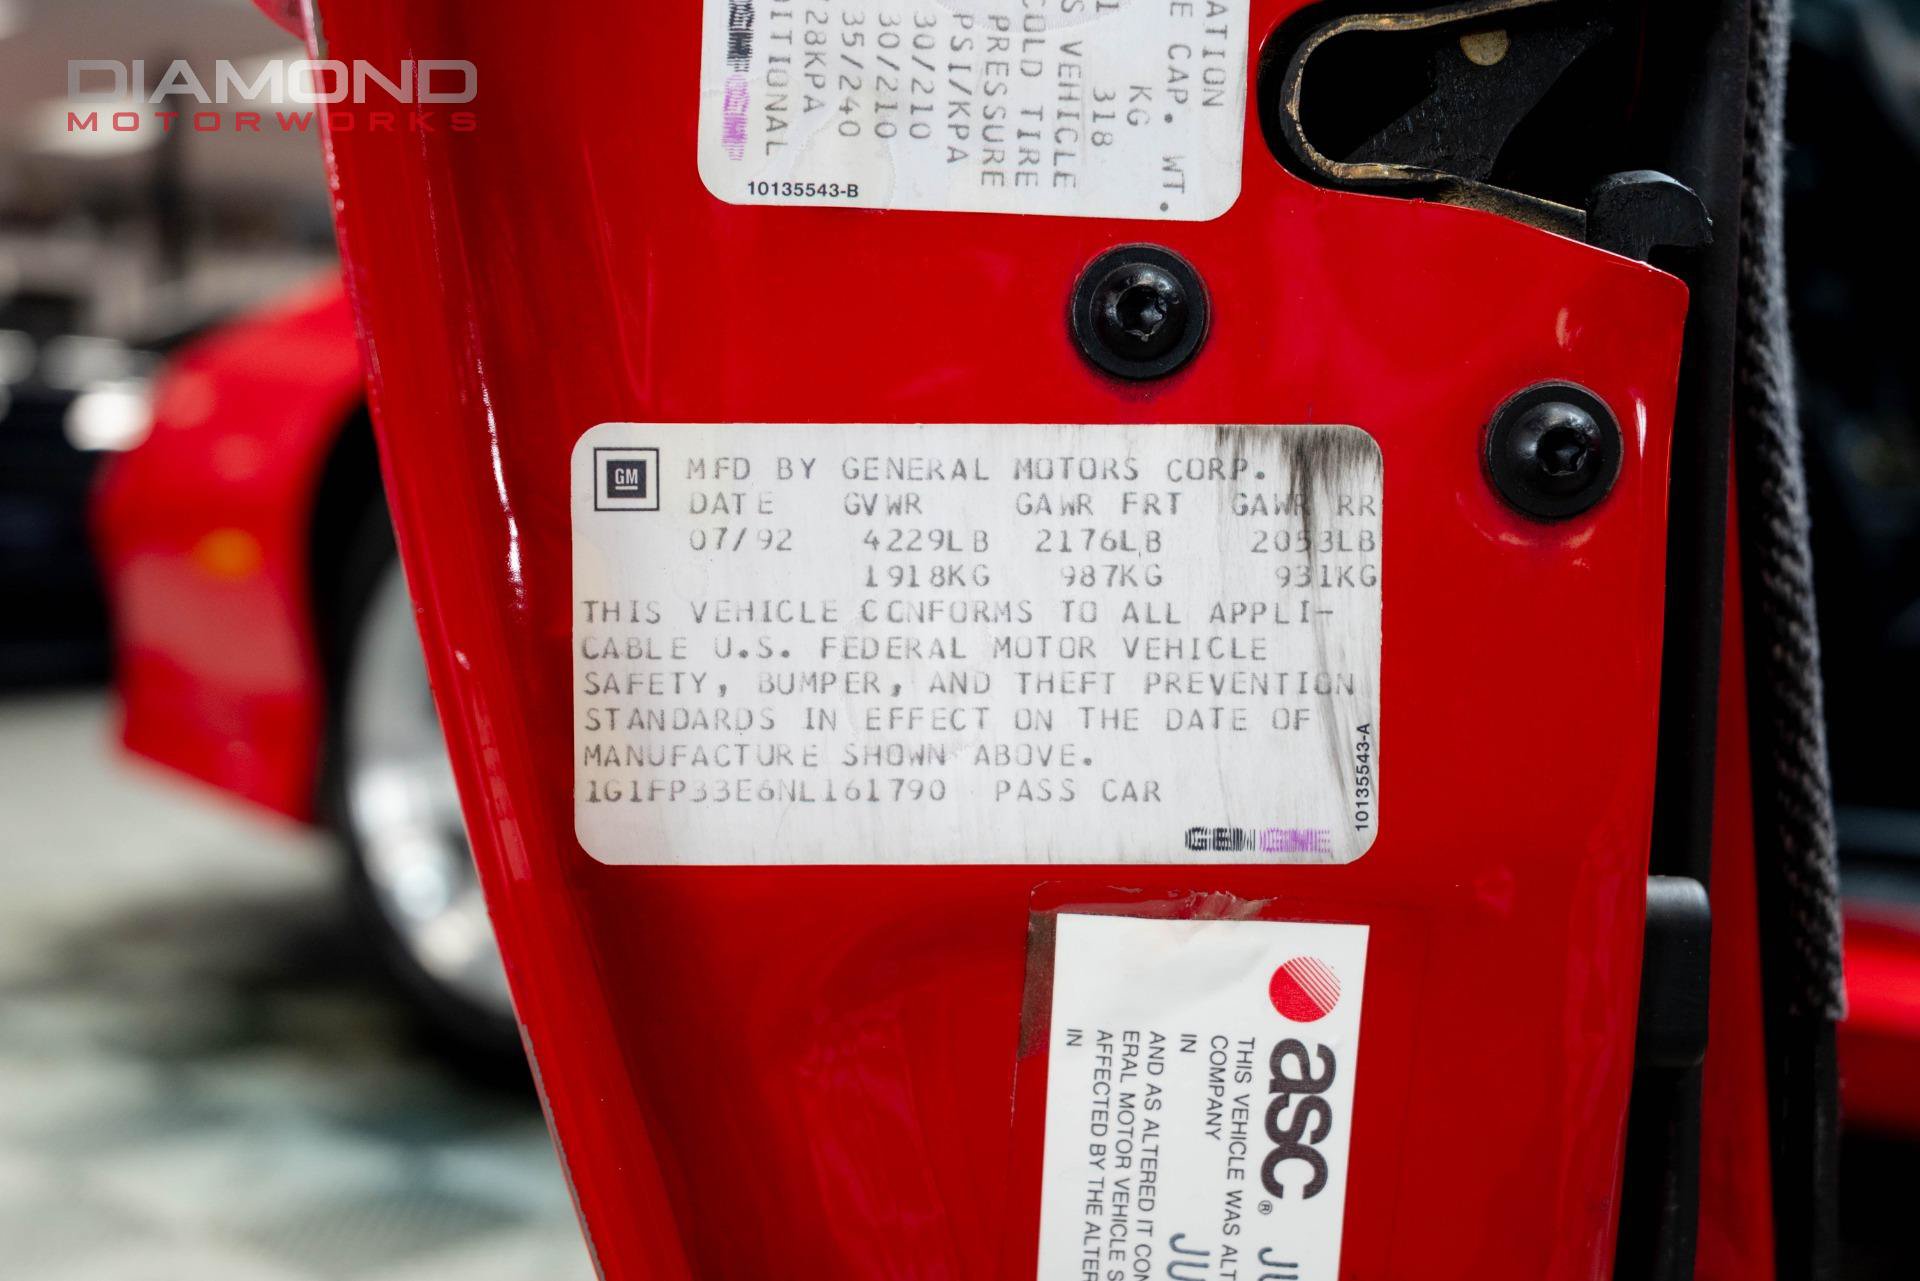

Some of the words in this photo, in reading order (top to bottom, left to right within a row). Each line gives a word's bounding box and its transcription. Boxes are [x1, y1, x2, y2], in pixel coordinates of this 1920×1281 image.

[764, 0, 792, 156] ITIONAL
[803, 0, 829, 113] 28KPA
[838, 12, 865, 137] 35/240
[874, 13, 901, 139] 30/210
[909, 11, 937, 140] 30/210
[1202, 0, 1228, 107] ATION
[947, 13, 975, 164] PSI/KPA
[981, 14, 1011, 187] PRESSURE
[1126, 85, 1153, 127] KG
[1163, 44, 1192, 124] CAP.
[1053, 41, 1083, 189] VEHICLE
[1091, 87, 1117, 147] 318
[1014, 106, 1044, 187] TIRE
[747, 181, 859, 198] 10135543-B
[1159, 154, 1186, 212] WT.
[614, 467, 639, 485] GM
[686, 456, 751, 481] MFD
[776, 456, 817, 481] BY
[842, 457, 990, 481] GENERAL
[1013, 457, 1140, 481] MOTORS
[1166, 457, 1266, 483] CORP.
[688, 492, 775, 515] DATE
[844, 492, 924, 516] GVWR
[1015, 492, 1094, 517] GAWR
[1122, 492, 1183, 516] FRT
[1231, 492, 1311, 517] GAWR
[1336, 493, 1377, 517] RR
[689, 528, 793, 551] 07/92
[863, 528, 990, 553] 4229LB
[1035, 528, 1162, 553] 2176LB
[865, 564, 991, 588] 1918KG
[1060, 564, 1163, 588] 987KG
[1274, 564, 1378, 588] 931KG
[583, 600, 661, 624] THIS
[690, 600, 838, 624] VEHICLE
[860, 600, 1033, 624] CONFORMS
[1062, 600, 1099, 624] TO
[1121, 600, 1182, 624] ALL
[1209, 600, 1334, 624] APPLI-
[581, 636, 688, 660] CABLE
[714, 636, 791, 660] U.S.
[820, 636, 967, 660] FEDERAL
[993, 636, 1098, 660] MOTOR
[1122, 636, 1267, 660] VEHICLE
[583, 671, 728, 696] SAFETY,
[758, 672, 902, 697] BUMPER,
[929, 672, 992, 696] AND
[1018, 671, 1117, 696] THEFT
[1143, 672, 1355, 696] PREVENTION
[584, 707, 776, 731] STANDARDS
[805, 707, 838, 731] IN
[865, 707, 991, 731] EFFECT
[1014, 708, 1054, 732] ON
[1078, 707, 1140, 732] THE
[1165, 708, 1249, 732] DATE
[1271, 708, 1311, 732] OF
[583, 743, 819, 768] MANUFACTURE
[842, 743, 946, 768] SHOWN
[973, 743, 1094, 768] ABOVE.
[1354, 722, 1372, 832] 10135543-A
[586, 779, 947, 802] 1G1FP33E6NL161790
[995, 779, 1076, 803] PASS
[1101, 779, 1162, 803] CAR
[1064, 1028, 1083, 1048] IN
[1118, 1030, 1141, 1084] ERAL
[1145, 1030, 1166, 1076] AND
[1180, 1033, 1197, 1054] IN
[1233, 1036, 1256, 1085] THIS
[1091, 1030, 1114, 1138] AFFECTED
[1143, 1083, 1162, 1112] AS
[1204, 1034, 1229, 1141] COMPANY
[1113, 1093, 1136, 1169] MOTOR
[1225, 1093, 1250, 1181] VEHICLE
[1259, 1037, 1337, 1200] asc
[1088, 1143, 1106, 1171] BY
[1136, 1118, 1160, 1213] ALTERED
[1085, 1176, 1105, 1216] THE
[1107, 1177, 1131, 1262] VEHICLE
[1221, 1189, 1245, 1236] WAS
[1136, 1219, 1153, 1237] IT
